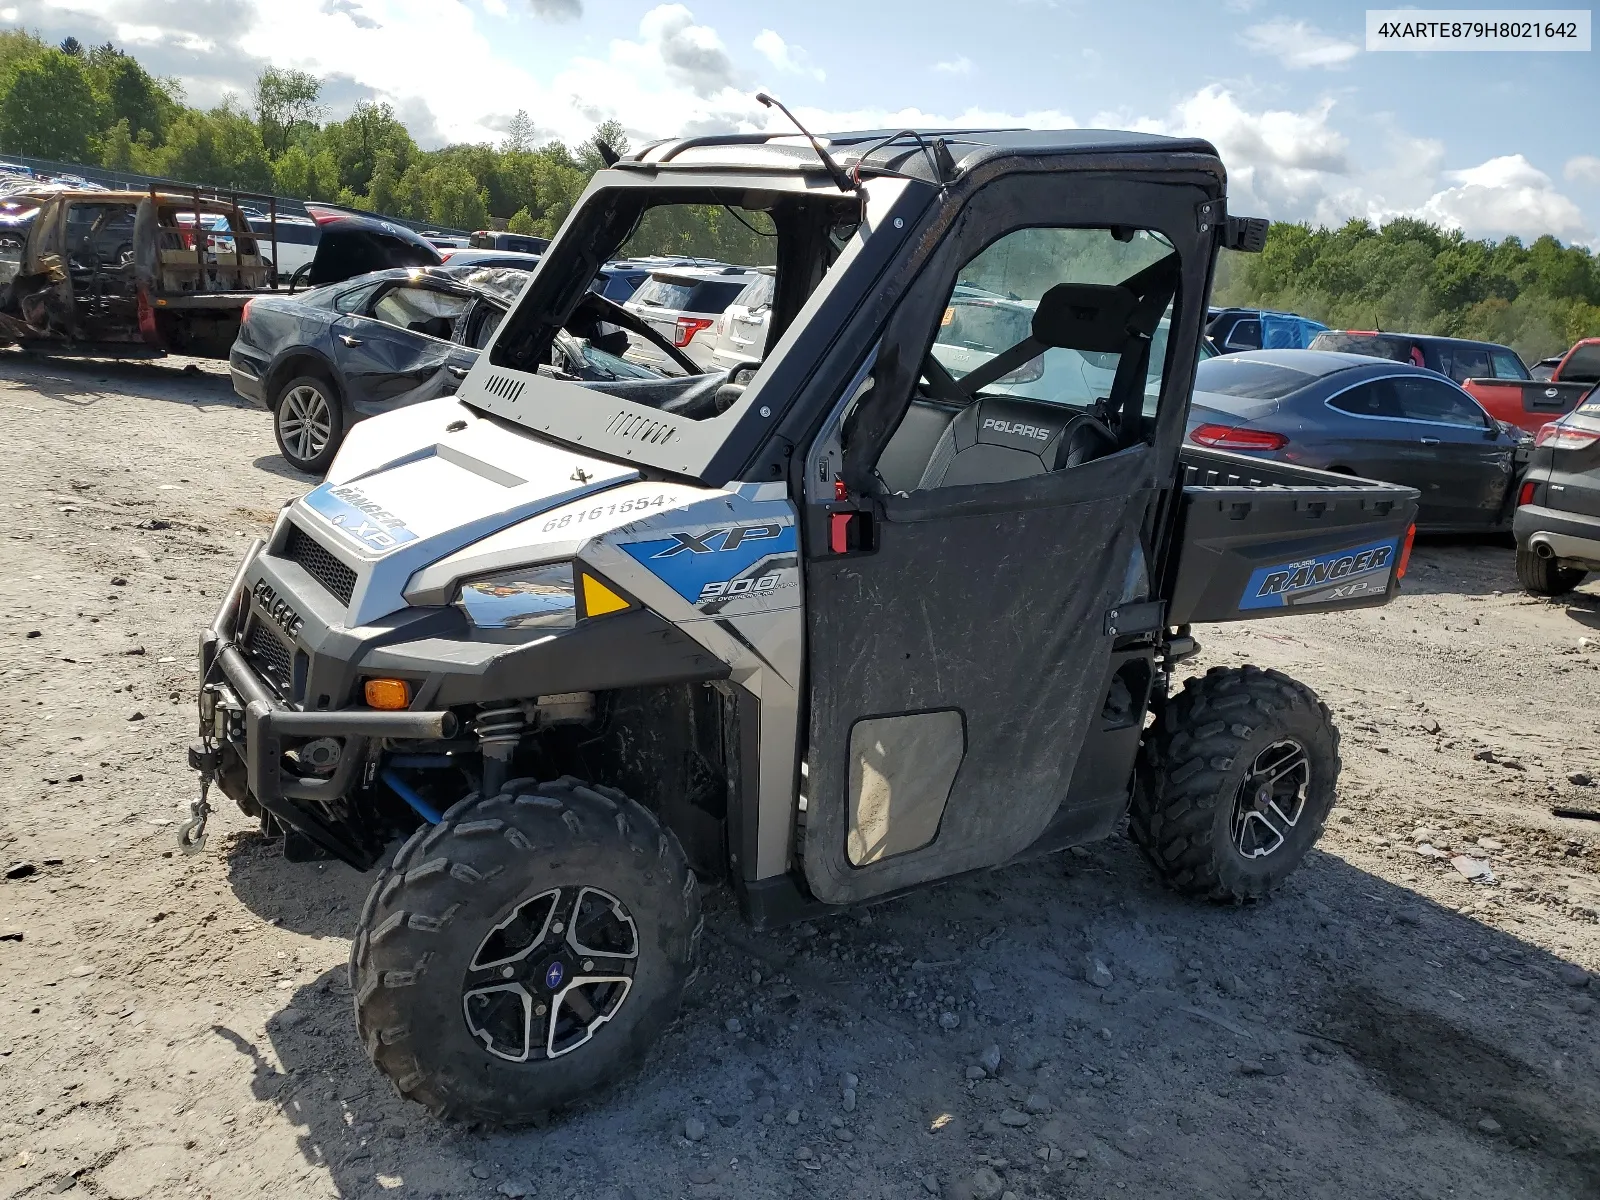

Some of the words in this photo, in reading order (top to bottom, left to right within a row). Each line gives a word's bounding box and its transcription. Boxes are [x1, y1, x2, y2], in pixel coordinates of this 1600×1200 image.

[983, 418, 1050, 440] POLARIS
[330, 488, 407, 529] RANGER
[344, 520, 397, 546] XP
[650, 524, 782, 559] XP
[1256, 545, 1392, 597] RANGER
[1288, 558, 1316, 569] POLARIS
[699, 574, 781, 598] 900
[1329, 582, 1367, 599] XP
[252, 577, 305, 644] POLARIS
